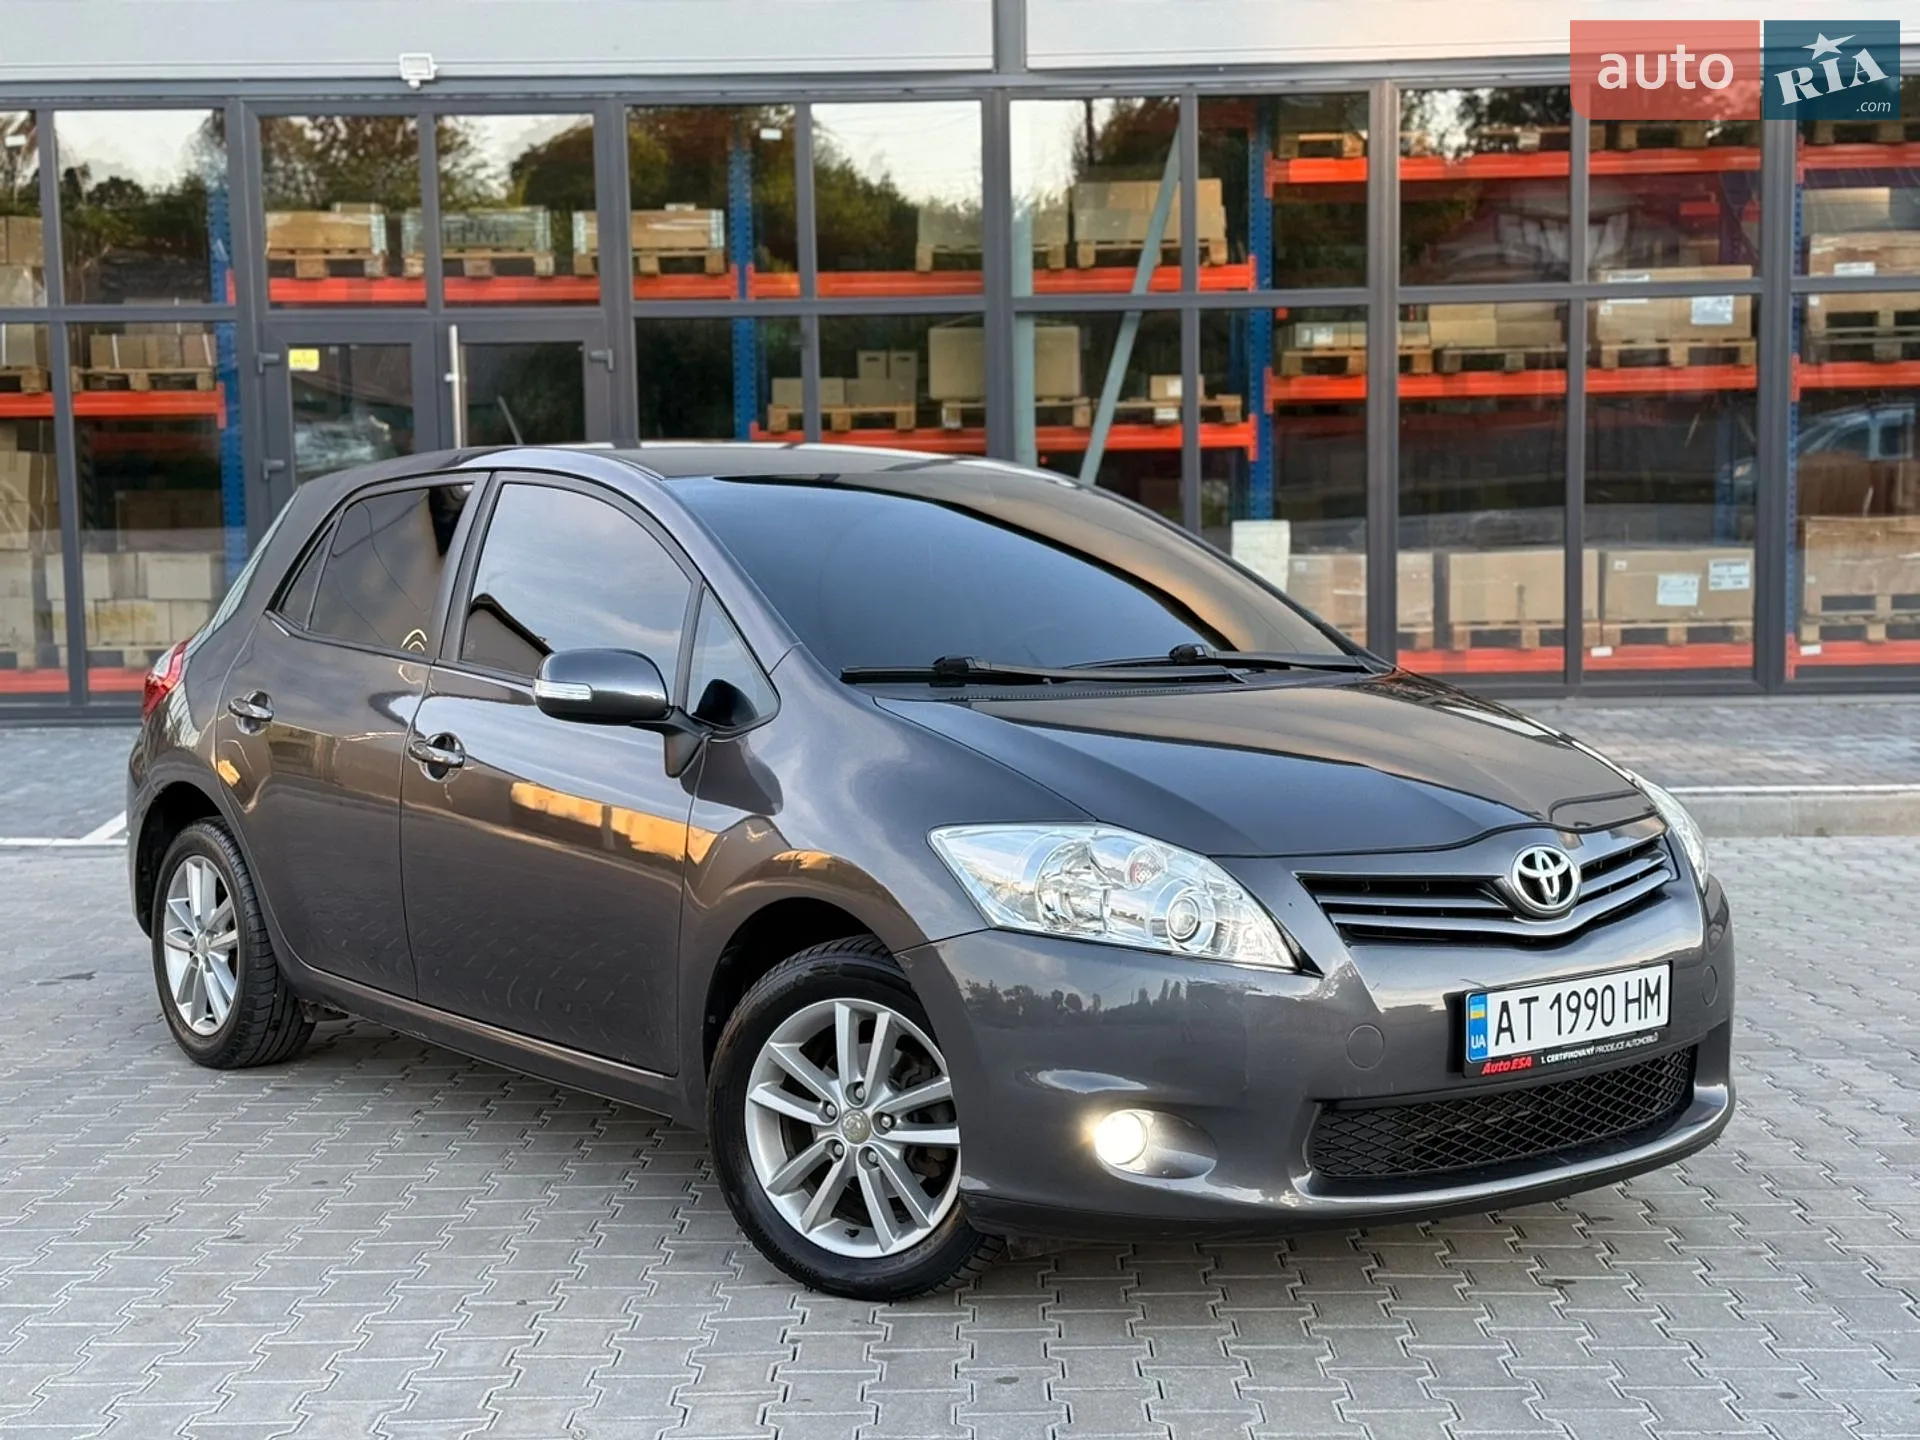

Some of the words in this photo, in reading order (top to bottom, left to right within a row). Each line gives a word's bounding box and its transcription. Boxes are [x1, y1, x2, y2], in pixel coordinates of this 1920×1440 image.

[1495, 996, 1540, 1046] AT
[1549, 985, 1616, 1036] 1990
[1624, 975, 1662, 1023] HM
[1471, 1036, 1487, 1048] UA
